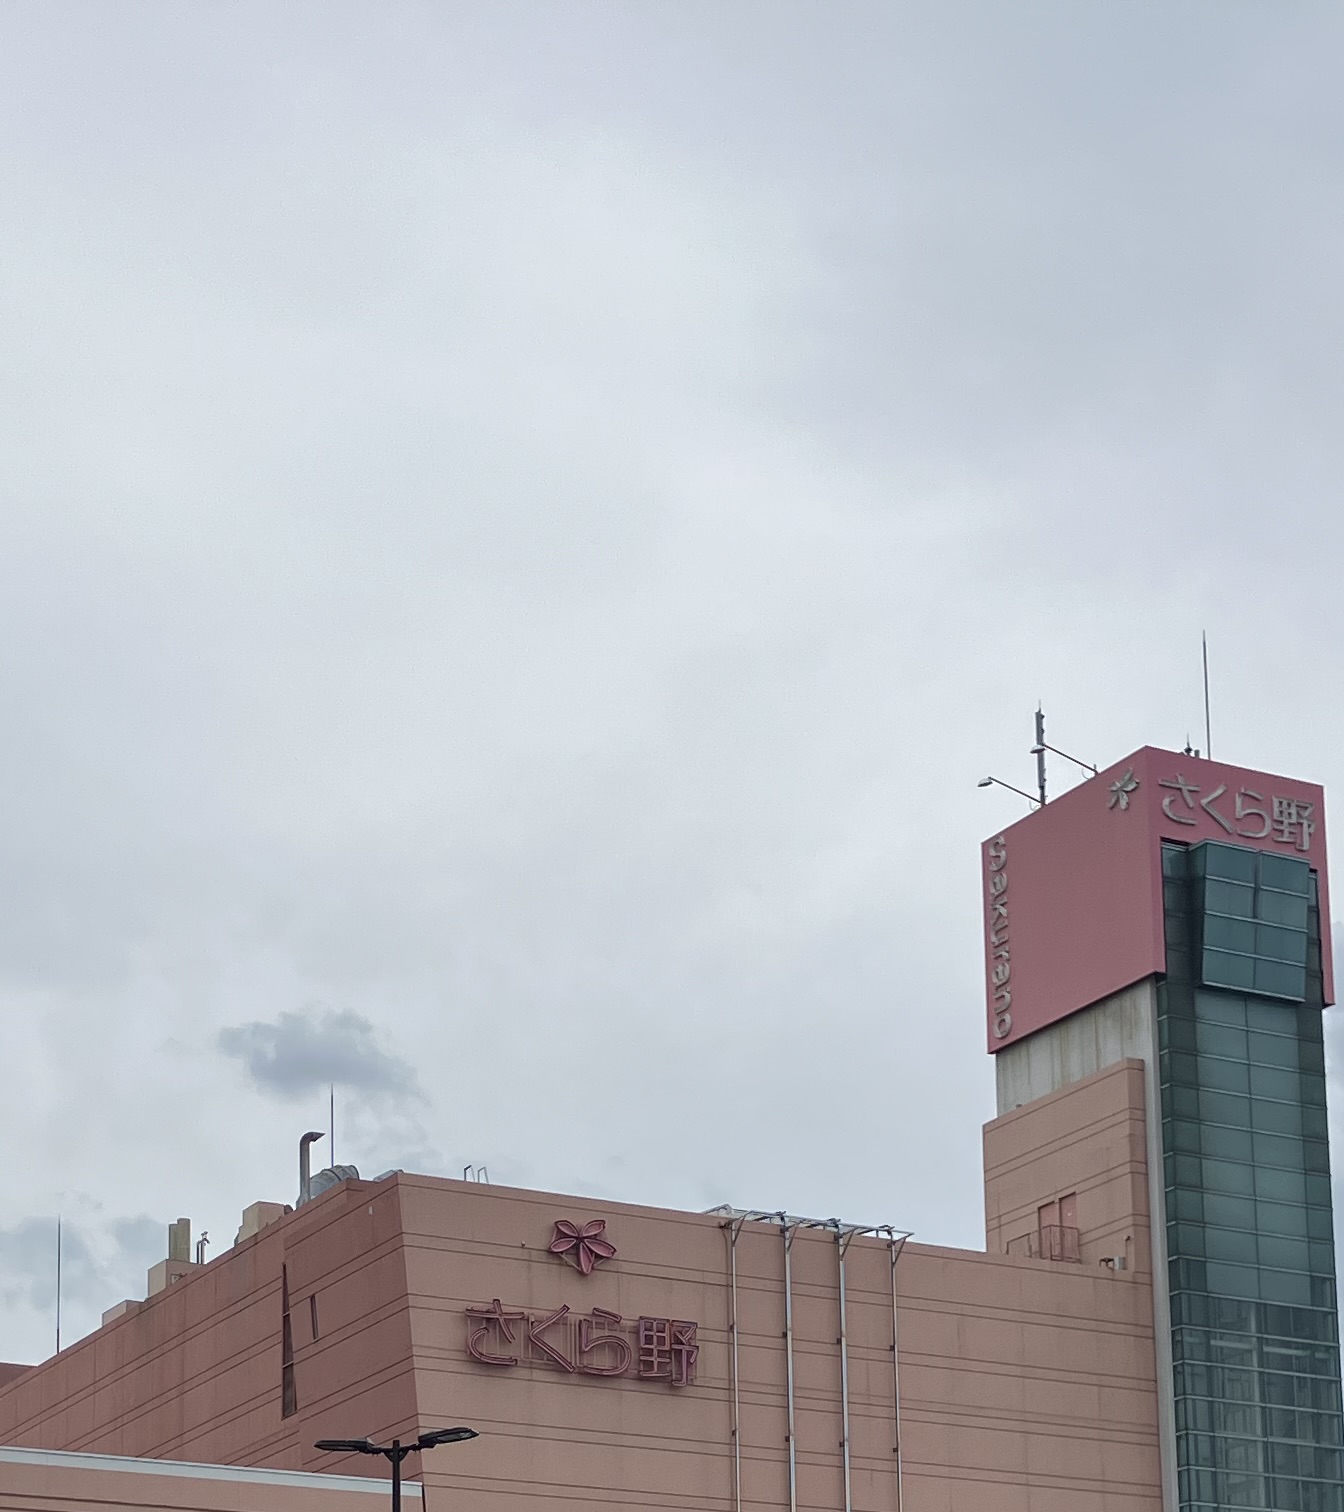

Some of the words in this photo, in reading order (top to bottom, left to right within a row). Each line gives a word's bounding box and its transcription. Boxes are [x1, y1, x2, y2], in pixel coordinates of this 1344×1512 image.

[1159, 773, 1316, 851] さくら野
[466, 1299, 699, 1387] さくら野
